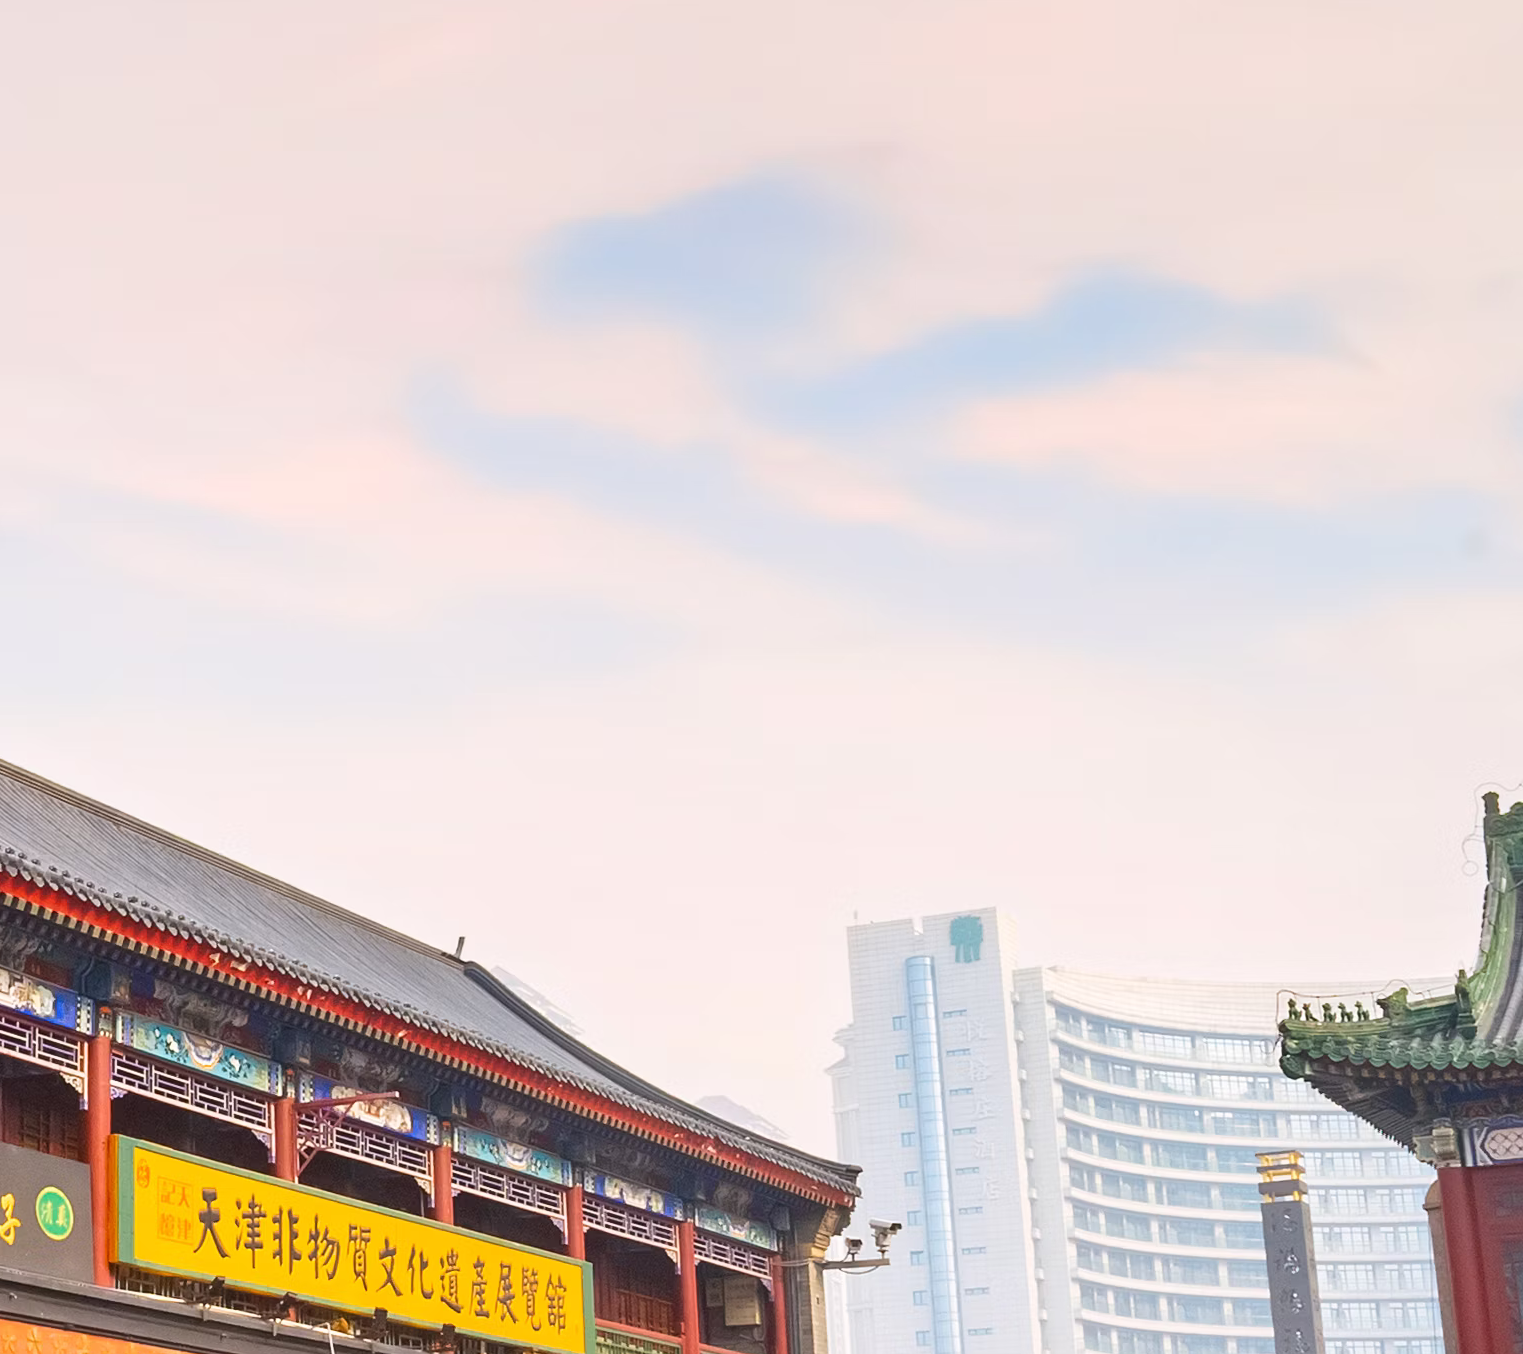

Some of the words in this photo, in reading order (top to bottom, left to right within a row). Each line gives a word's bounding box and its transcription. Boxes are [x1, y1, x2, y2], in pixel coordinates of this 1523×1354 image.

[194, 1188, 568, 1336] 天津非物質文化遺產展覽館
